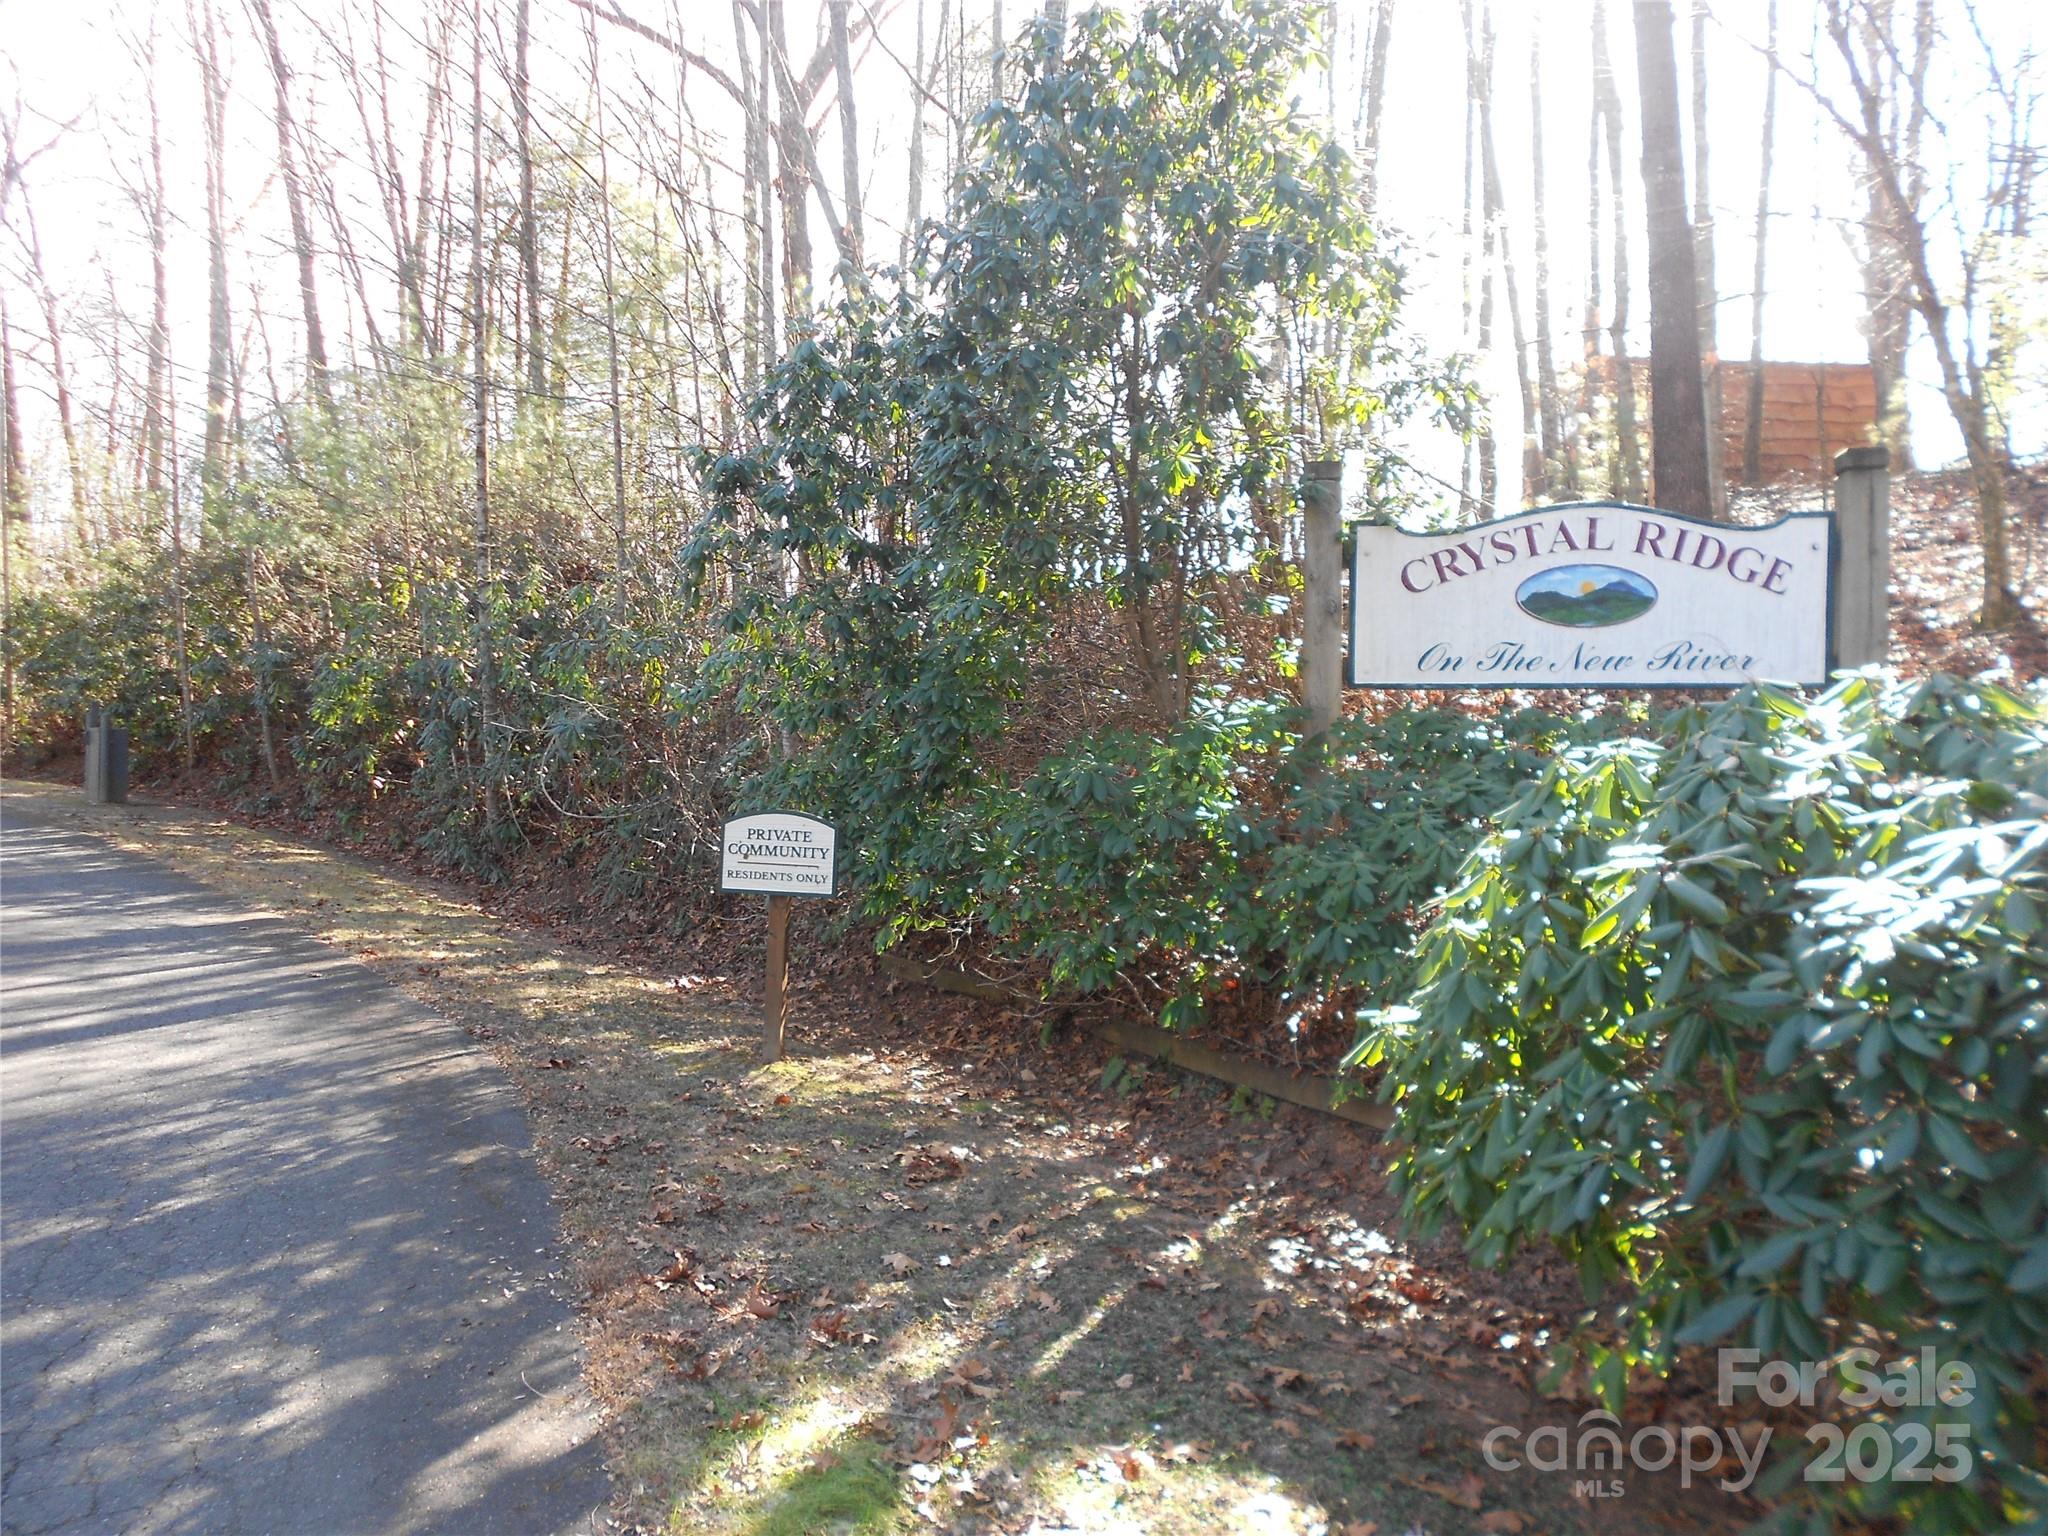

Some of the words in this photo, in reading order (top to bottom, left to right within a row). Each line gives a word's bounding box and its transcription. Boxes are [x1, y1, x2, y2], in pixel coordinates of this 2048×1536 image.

[1400, 516, 1614, 593] CRYSTAL
[1634, 520, 1794, 595] RIDGE
[1417, 641, 1463, 672] On
[1476, 641, 1544, 672] The
[1549, 641, 1635, 672] New
[1646, 640, 1757, 672] River
[747, 828, 812, 842] PRIVATE
[728, 843, 830, 859] COMMUNITY
[727, 869, 793, 881] RESIDENTS
[796, 873, 828, 884] ONLY
